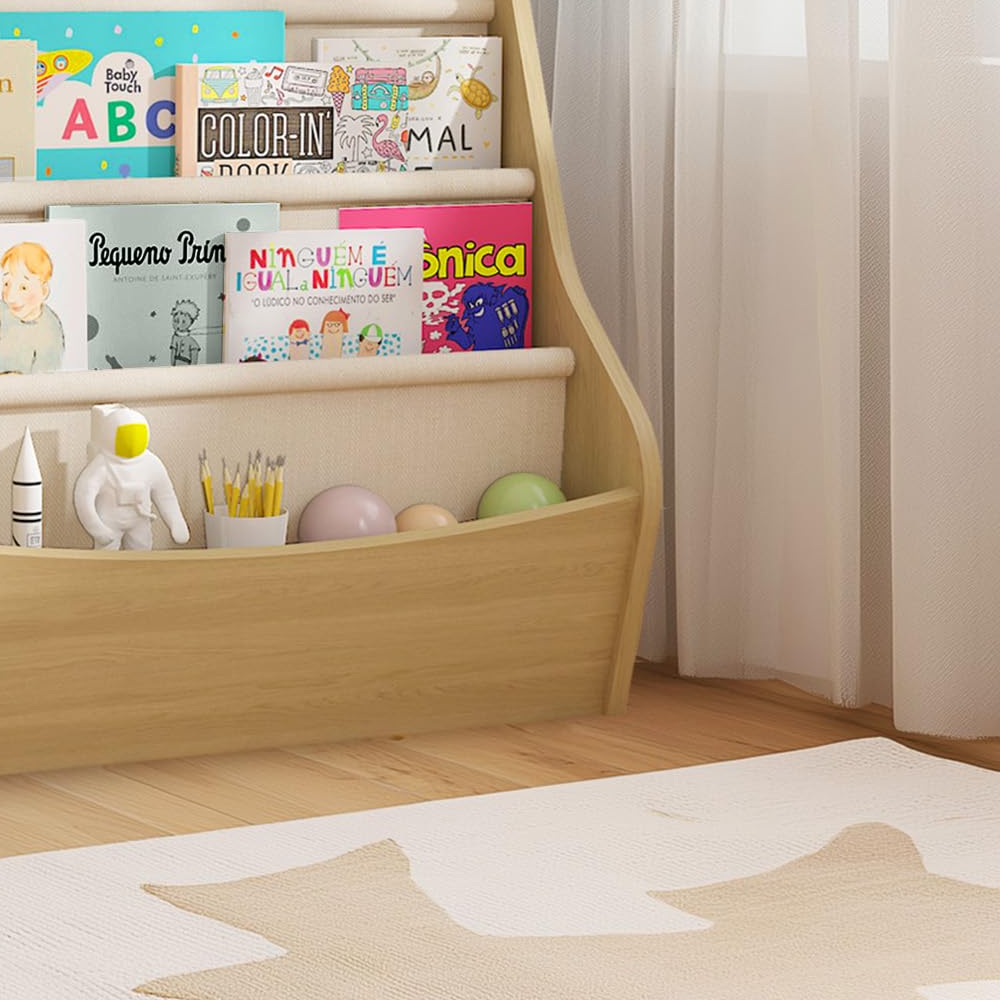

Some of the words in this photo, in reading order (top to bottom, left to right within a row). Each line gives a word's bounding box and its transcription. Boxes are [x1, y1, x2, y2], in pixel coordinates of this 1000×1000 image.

[104, 80, 142, 95] Touch
[105, 68, 139, 85] Baby
[405, 123, 473, 153] MAL
[88, 232, 172, 274] Pequeno
[371, 241, 387, 265] É
[236, 268, 299, 293] IGUAL
[300, 278, 309, 292] a
[292, 296, 305, 307] NO
[306, 294, 366, 307] CONHECIMENTO
[367, 294, 380, 304] DO
